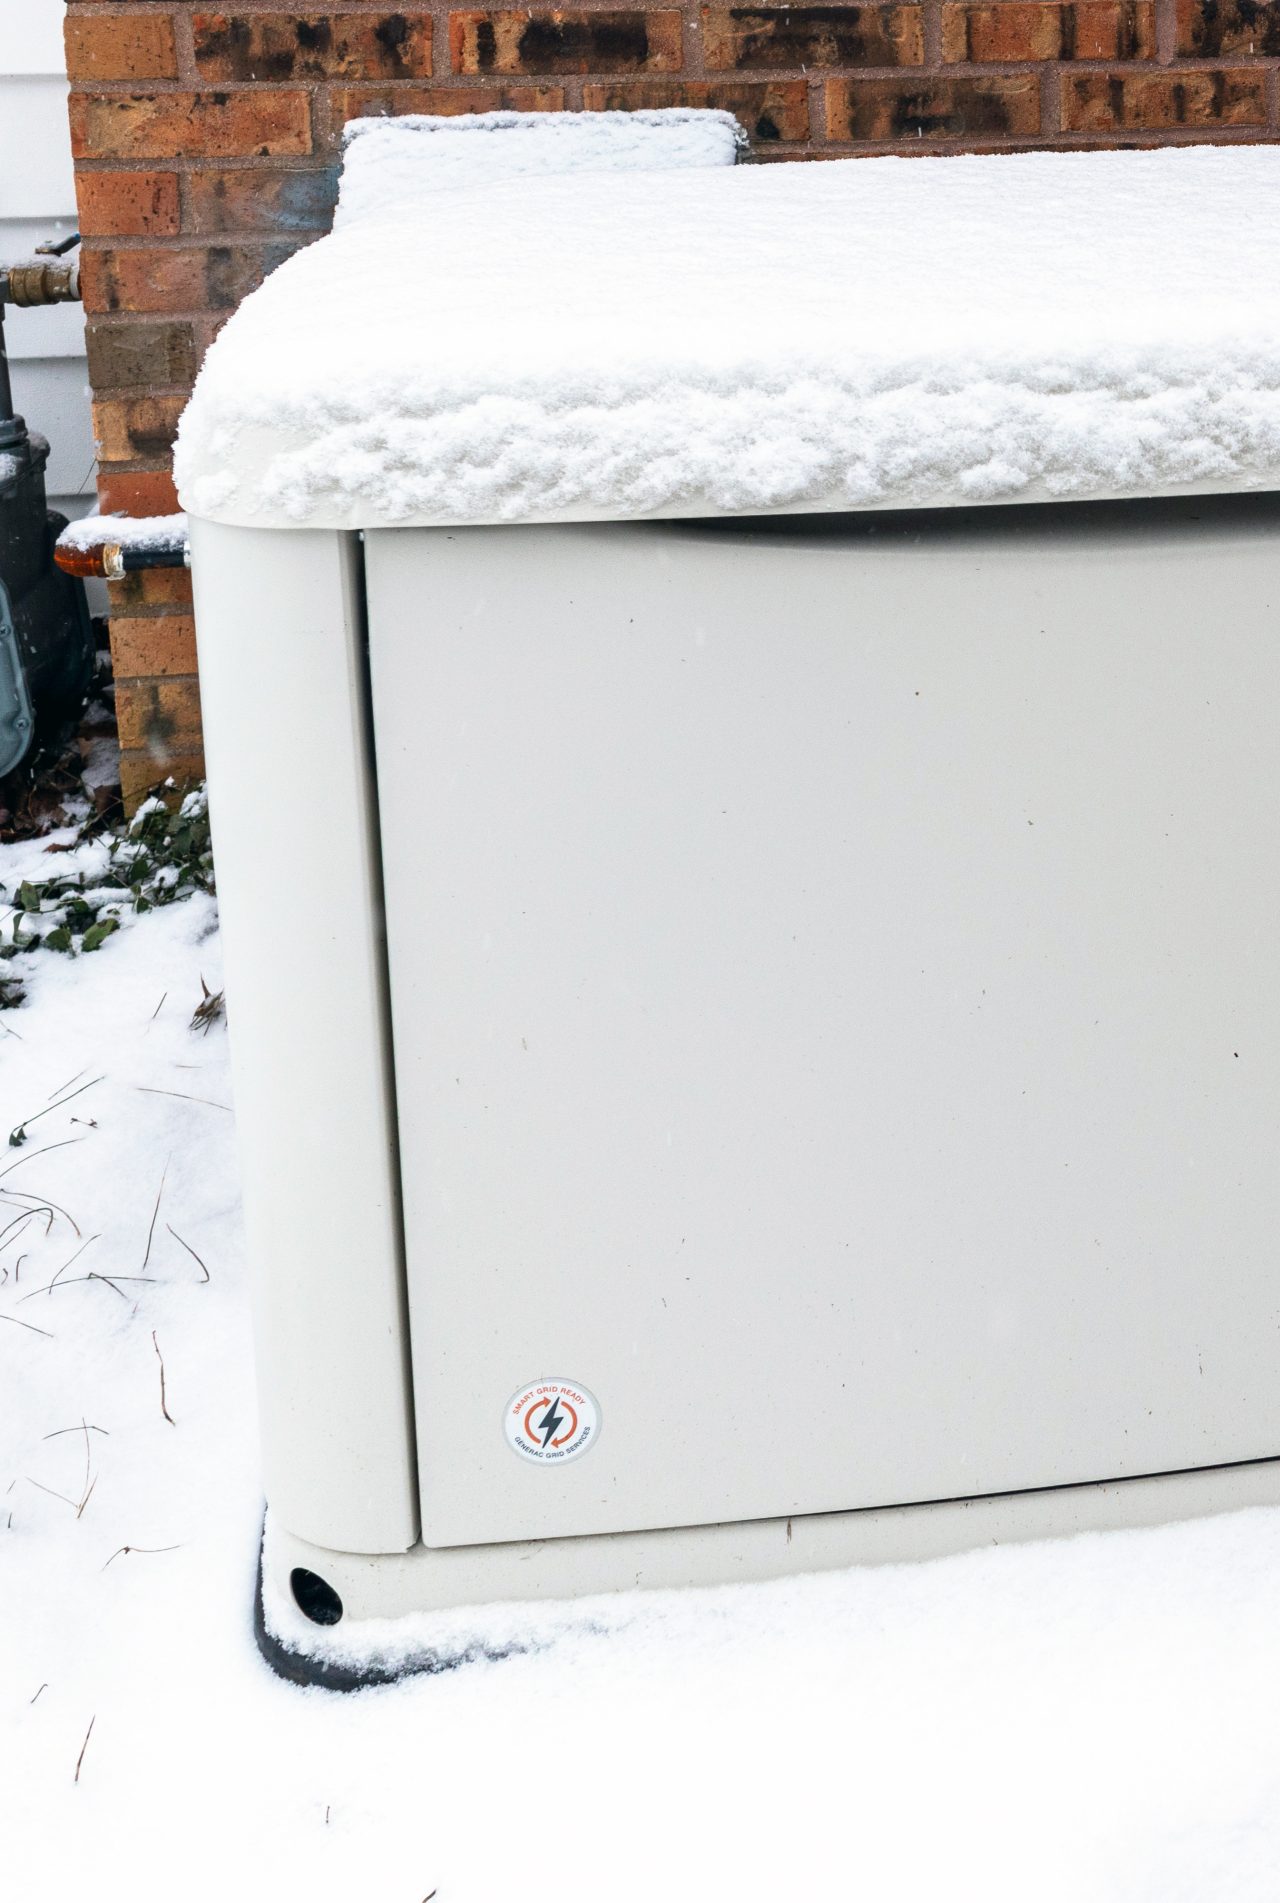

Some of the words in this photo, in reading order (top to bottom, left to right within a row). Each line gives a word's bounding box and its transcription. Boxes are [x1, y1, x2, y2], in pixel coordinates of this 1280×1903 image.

[513, 1391, 534, 1415] SMART
[537, 1386, 558, 1395] GRID
[560, 1387, 585, 1405] READY
[515, 1436, 543, 1458] GENERAC
[567, 1426, 590, 1454] SERVICES
